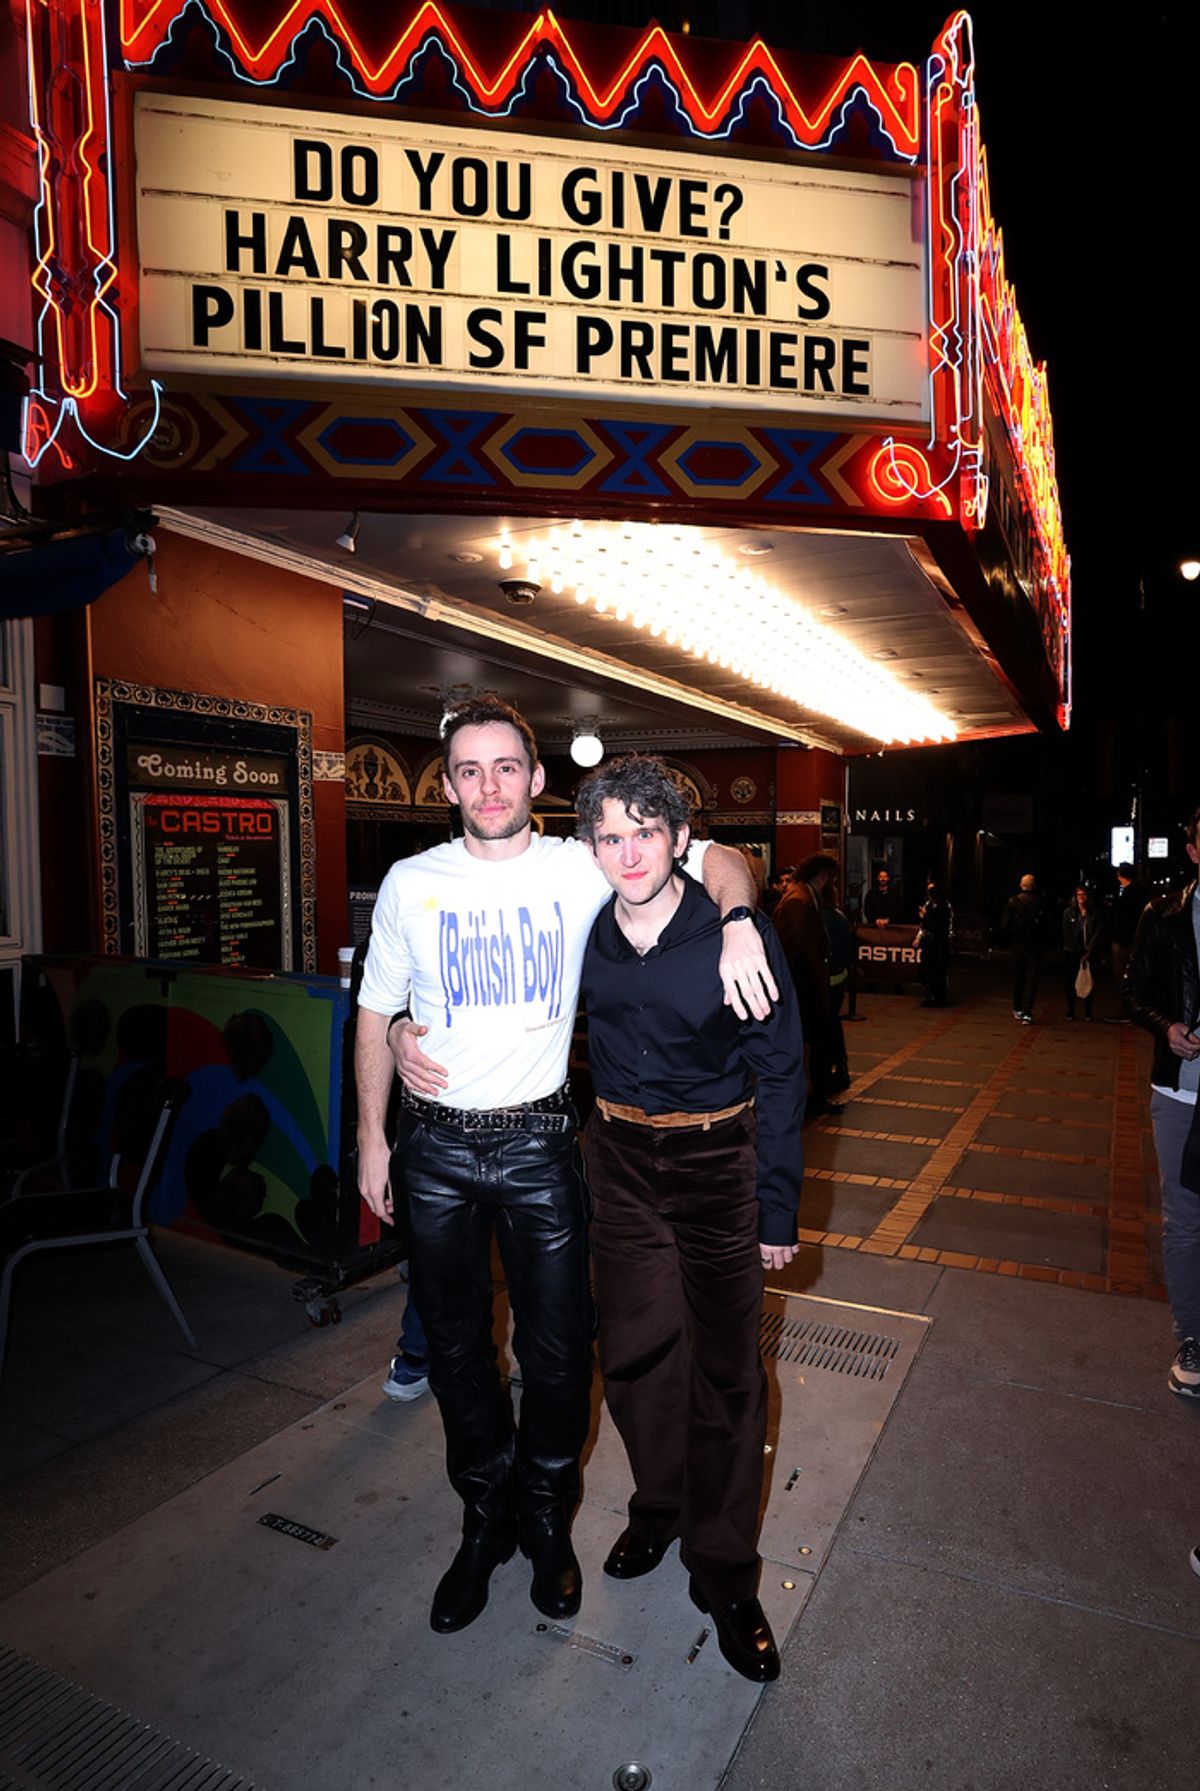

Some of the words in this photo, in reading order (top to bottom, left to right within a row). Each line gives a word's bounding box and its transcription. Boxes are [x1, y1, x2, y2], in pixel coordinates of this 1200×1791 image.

[293, 138, 378, 206] DO
[404, 150, 531, 220] YOU
[562, 167, 744, 240] GIVE?
[225, 210, 457, 290] HARRY
[496, 233, 831, 320] LIGHTON'S
[192, 285, 442, 366] PILLION
[469, 307, 546, 370] SF
[576, 316, 870, 396] PREMIERE
[137, 753, 228, 785] Coming
[233, 760, 280, 785] Soon
[160, 810, 273, 833] CASTRO
[855, 808, 916, 822] NAILS
